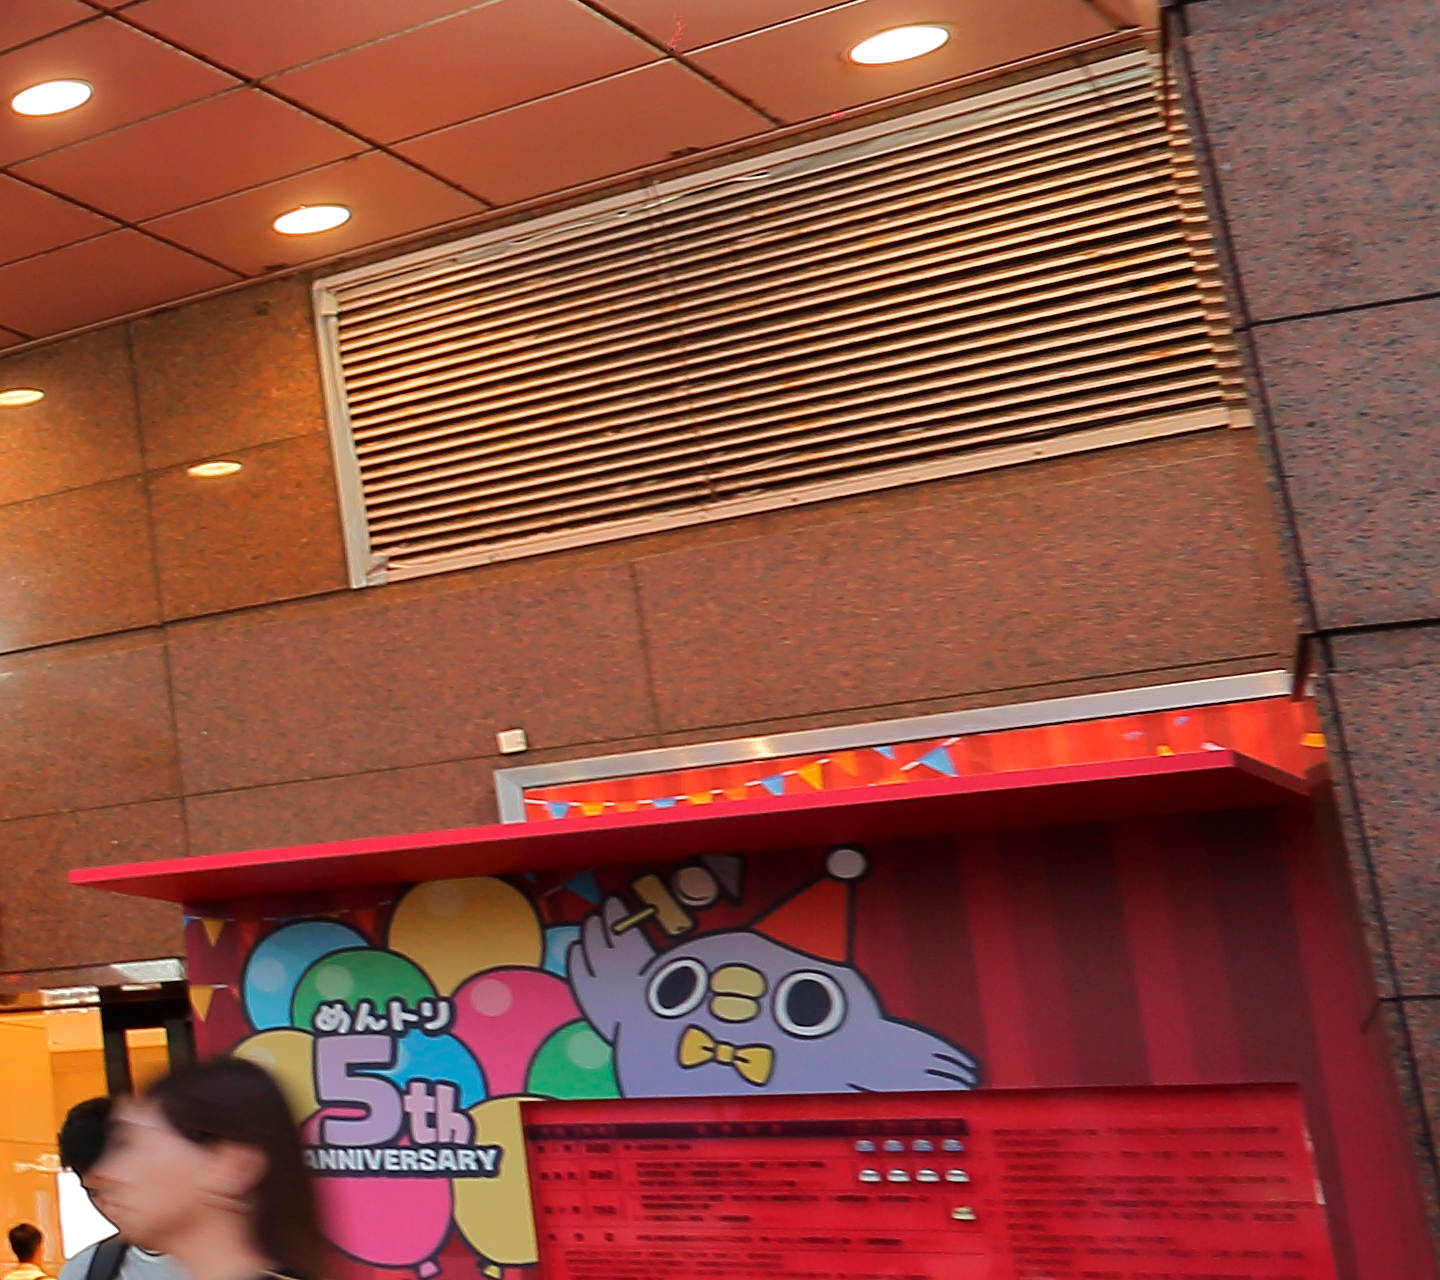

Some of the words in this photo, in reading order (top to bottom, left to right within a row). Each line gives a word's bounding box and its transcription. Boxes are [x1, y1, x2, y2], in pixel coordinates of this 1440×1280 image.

[313, 1000, 453, 1034] めんトリ
[315, 1034, 473, 1146] 5th
[303, 1148, 499, 1172] ANNIVERSARY
